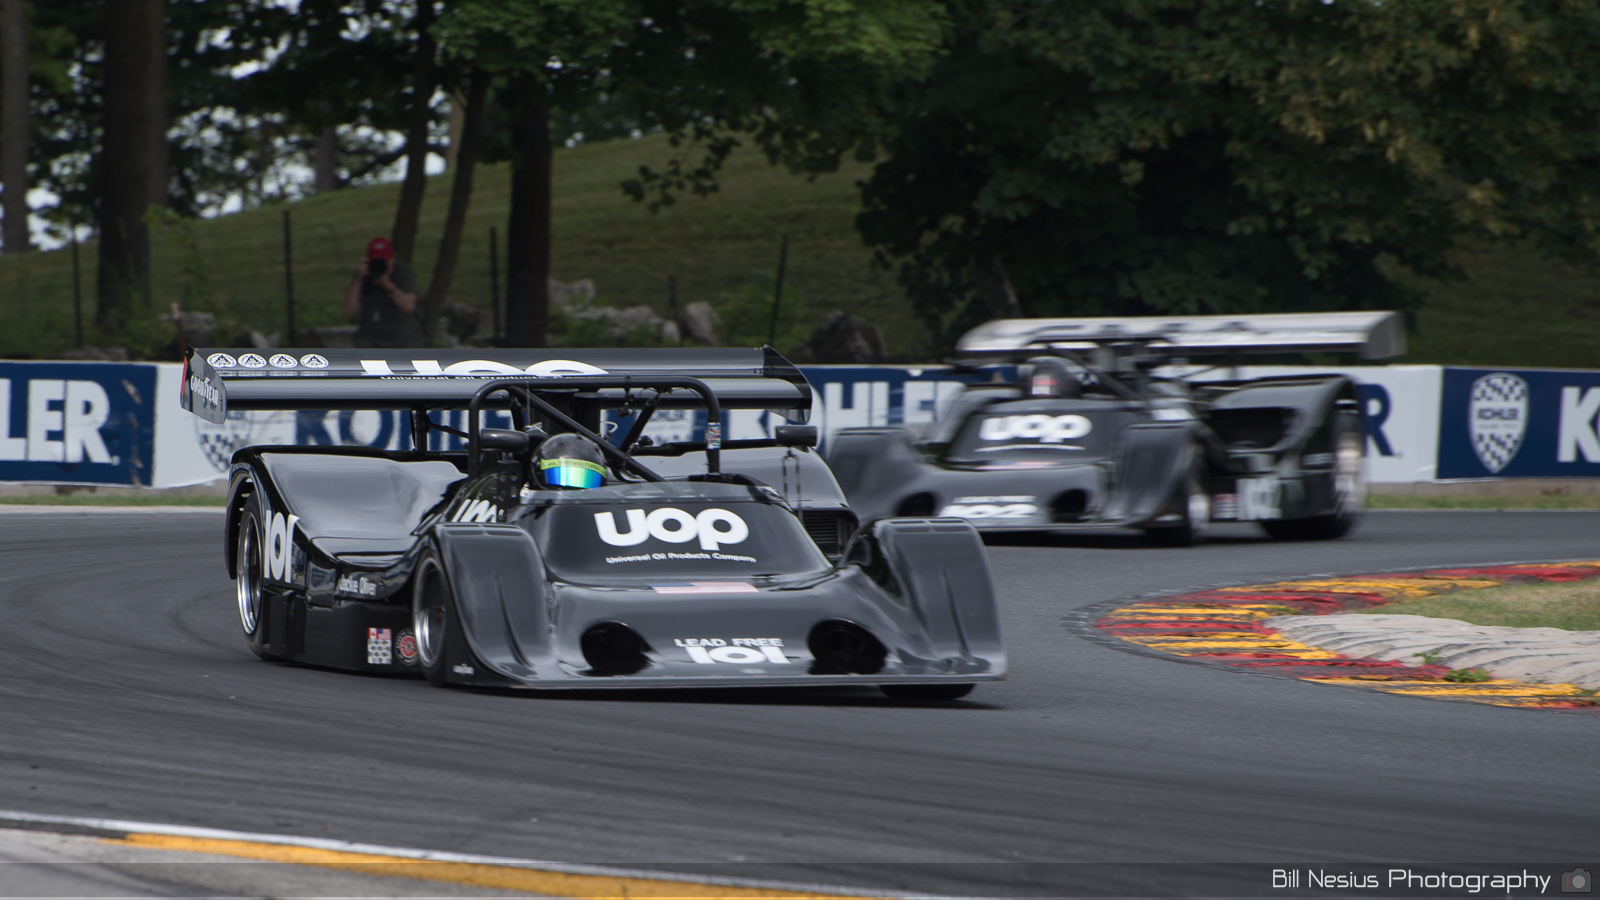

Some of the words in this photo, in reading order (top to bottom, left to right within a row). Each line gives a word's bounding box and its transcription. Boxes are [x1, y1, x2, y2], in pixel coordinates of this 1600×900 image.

[264, 509, 300, 583] 101
[606, 554, 650, 564] Universal
[668, 552, 711, 560] Products
[712, 552, 757, 563] Company
[340, 574, 358, 593] Jackie
[674, 638, 728, 648] LEAD
[731, 637, 785, 648] FREE
[685, 646, 791, 664] 101
